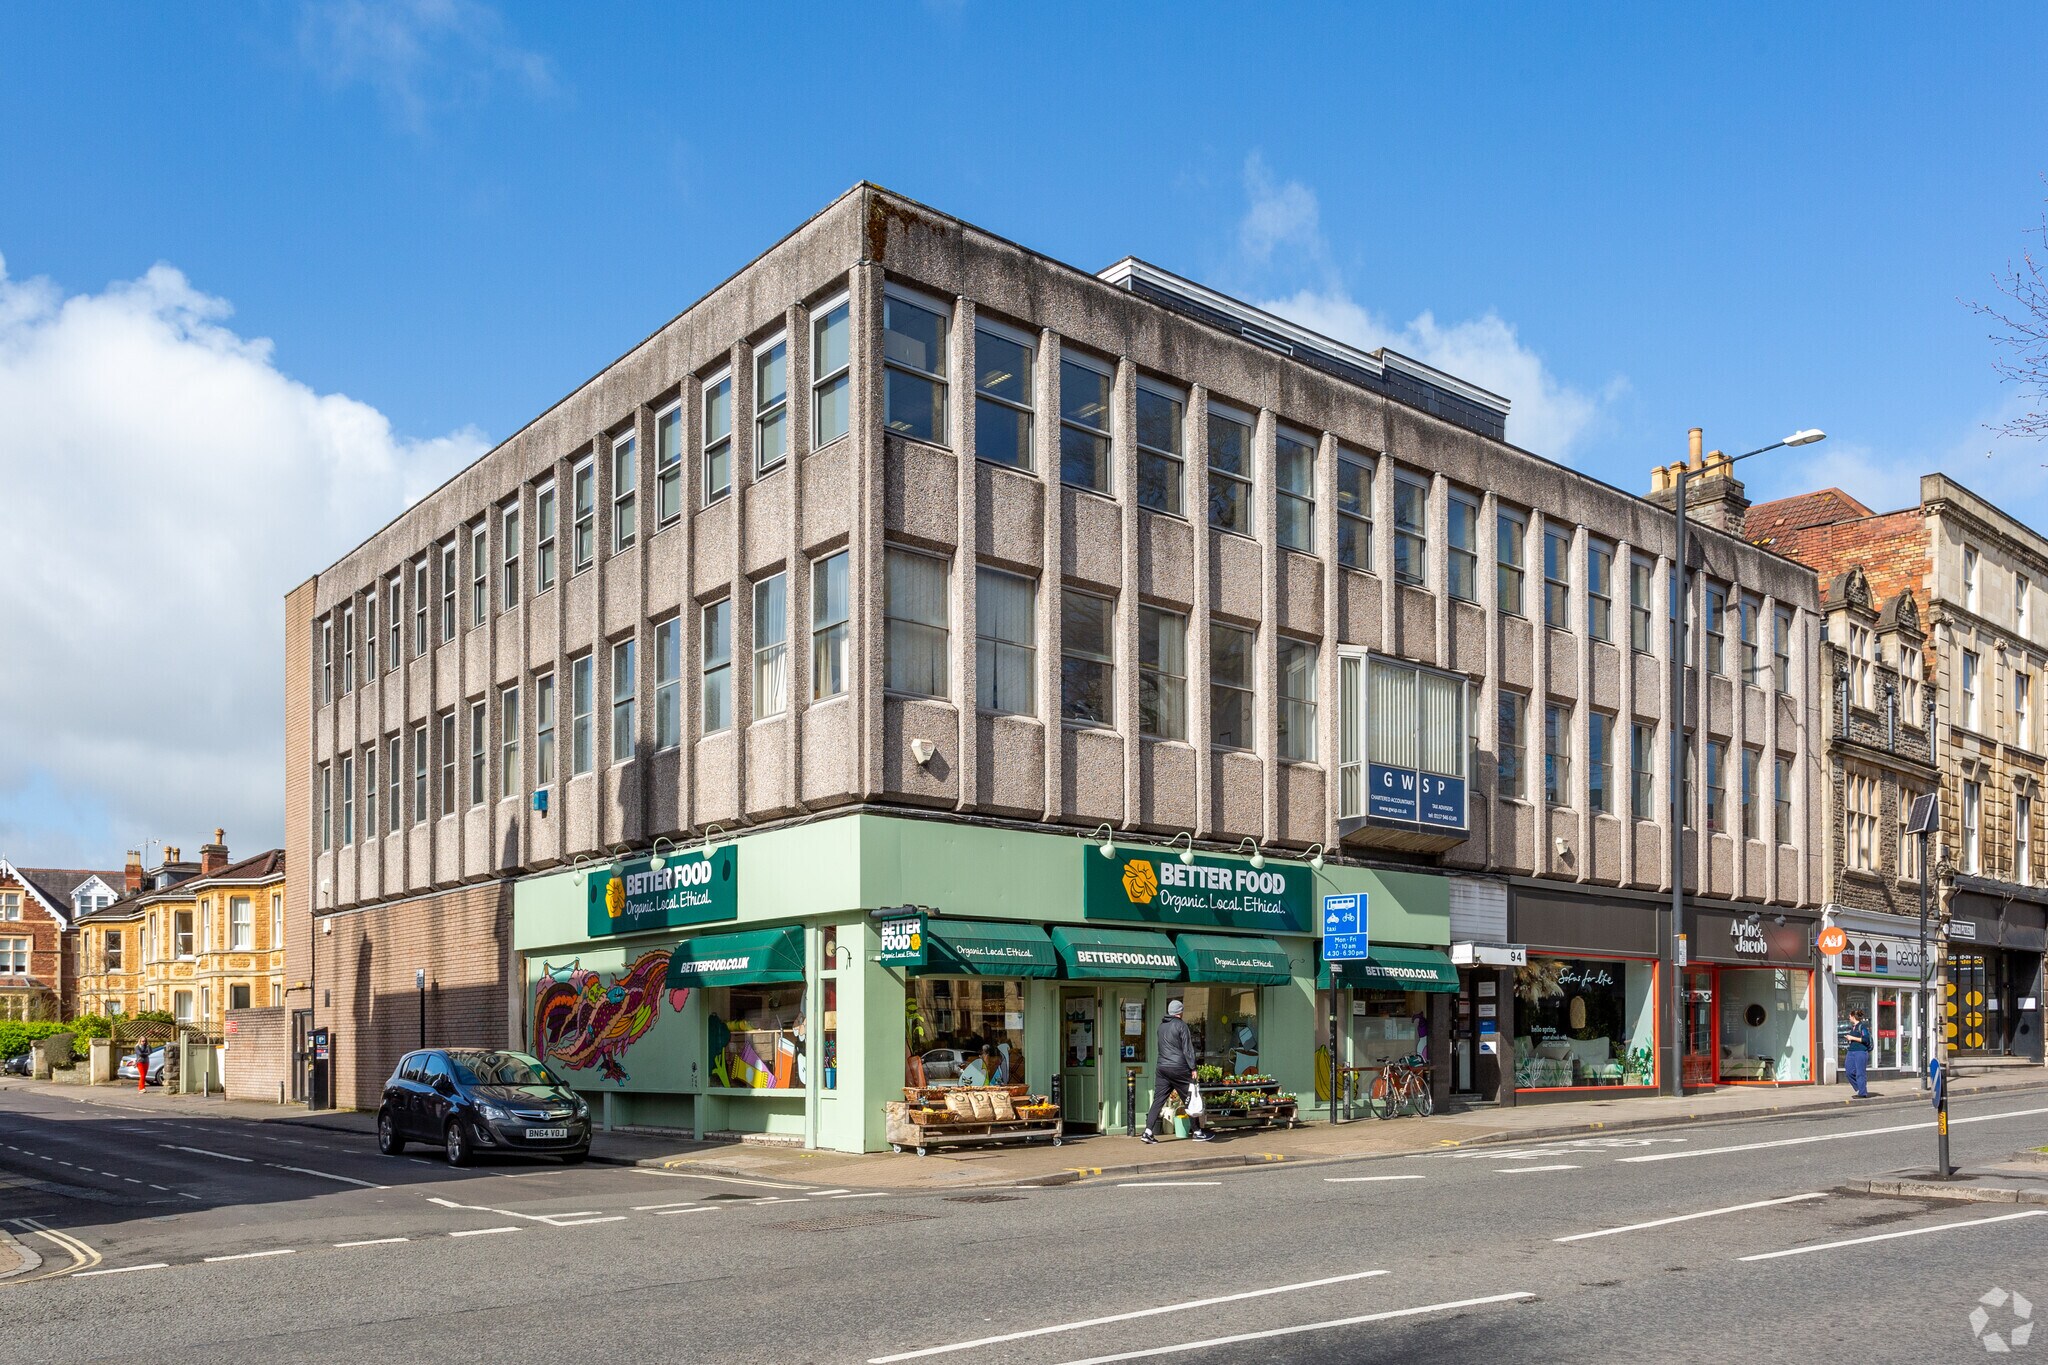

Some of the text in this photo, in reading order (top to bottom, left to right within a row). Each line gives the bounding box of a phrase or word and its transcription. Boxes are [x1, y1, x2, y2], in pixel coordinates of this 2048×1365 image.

[626, 860, 712, 896] BETTER FOOD
[1161, 862, 1286, 896] BETTER FOOD
[626, 888, 712, 921] Organic. Local. Ethical.
[1160, 889, 1286, 915] Organic. Local. Ethical.
[881, 918, 921, 935] BETTER
[881, 936, 910, 951] FOOD
[1735, 935, 1768, 955] Jacob
[1822, 934, 1843, 948] A&J
[956, 944, 1034, 959] Organic. Local. Ethical.
[1077, 950, 1178, 967] BETTERFOOD.CO.UK
[1356, 950, 1364, 958] pm
[1510, 951, 1523, 963] 94
[681, 957, 750, 974] BETTERFOOD.CO.UK
[1214, 955, 1274, 968] Organic. Local. Ethical.
[1365, 965, 1439, 980] BETTERFOOD.CO.UK
[1558, 967, 1614, 987] Sofas for life
